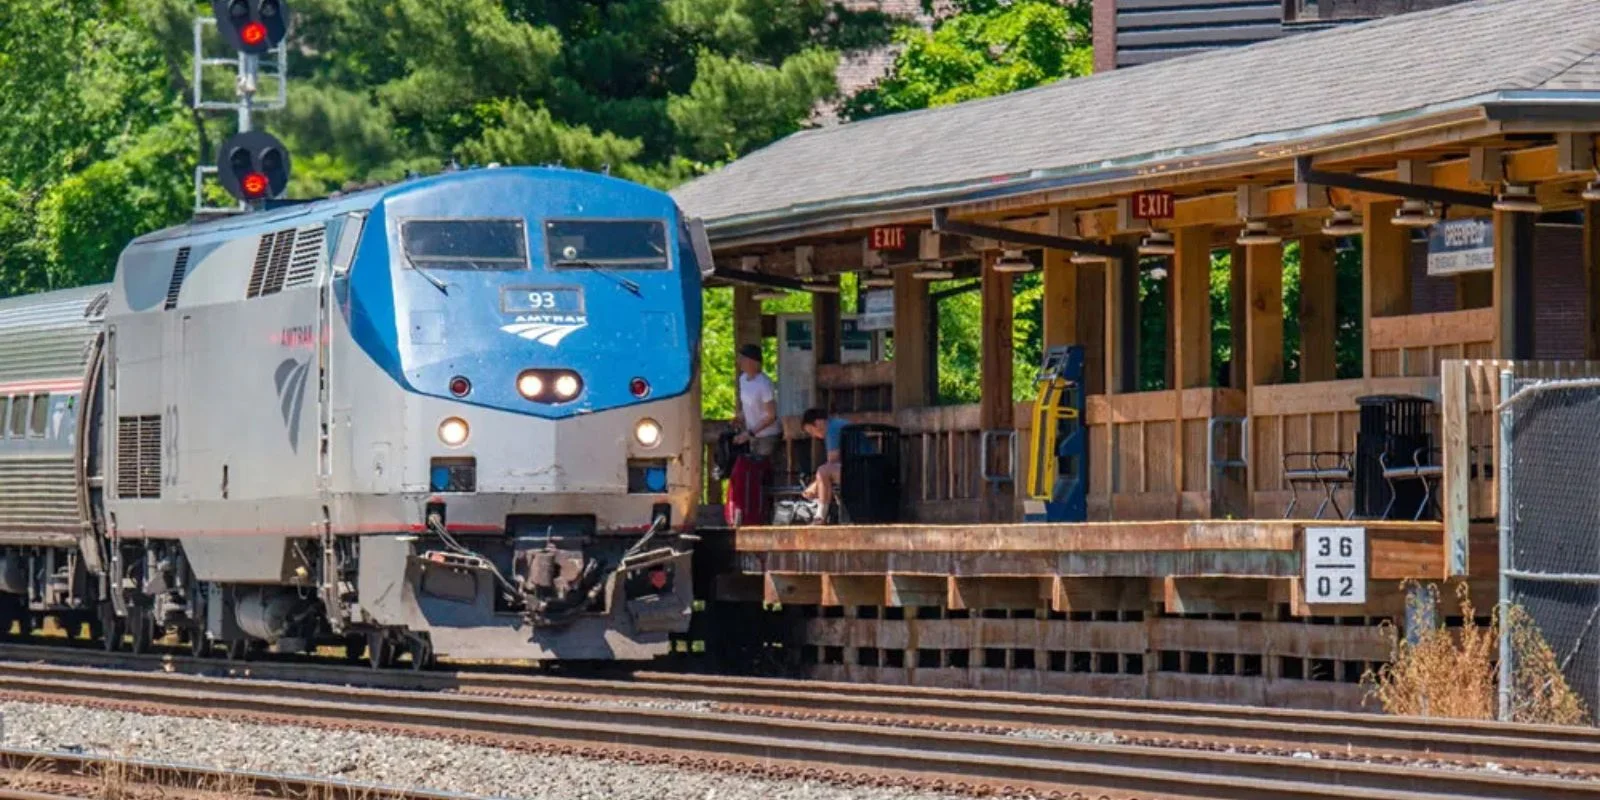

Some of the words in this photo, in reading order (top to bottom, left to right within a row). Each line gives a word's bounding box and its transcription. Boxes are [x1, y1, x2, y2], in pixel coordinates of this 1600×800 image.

[1139, 194, 1168, 216] EXIT
[874, 228, 902, 247] EXIT
[528, 292, 555, 308] 93
[515, 315, 587, 323] AMTRAK
